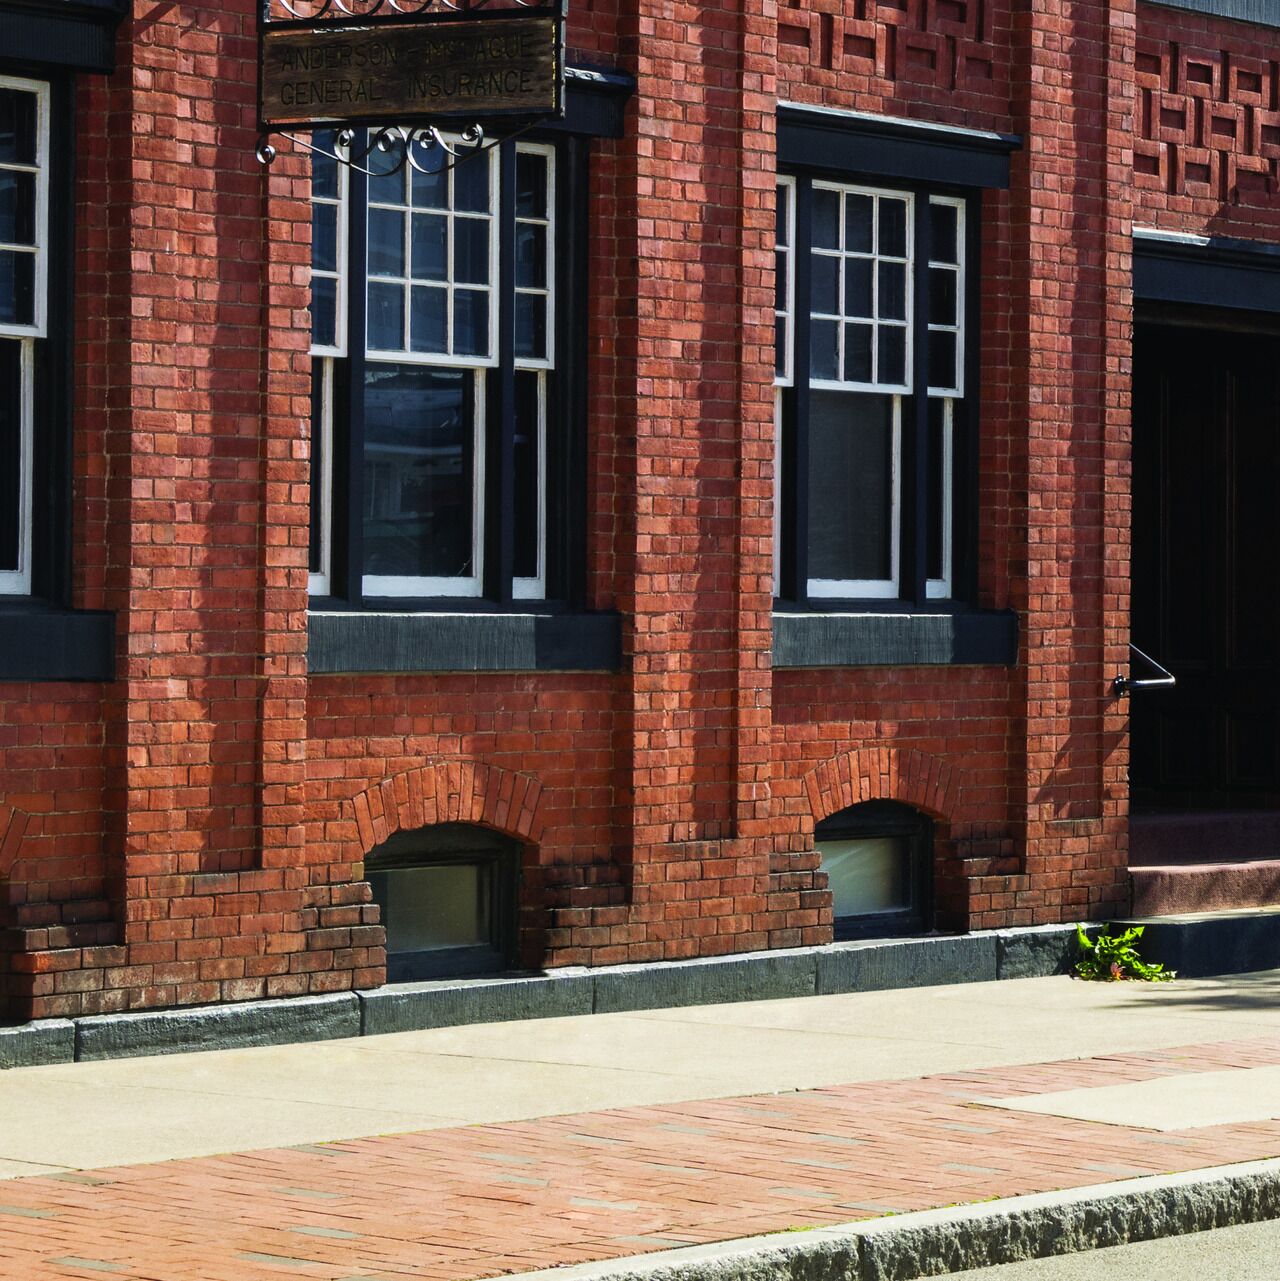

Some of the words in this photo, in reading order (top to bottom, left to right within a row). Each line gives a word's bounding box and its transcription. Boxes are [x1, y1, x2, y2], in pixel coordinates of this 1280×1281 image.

[281, 41, 398, 71] ANDERSON
[280, 77, 382, 107] GENERAL
[408, 68, 532, 99] INSURANCE
